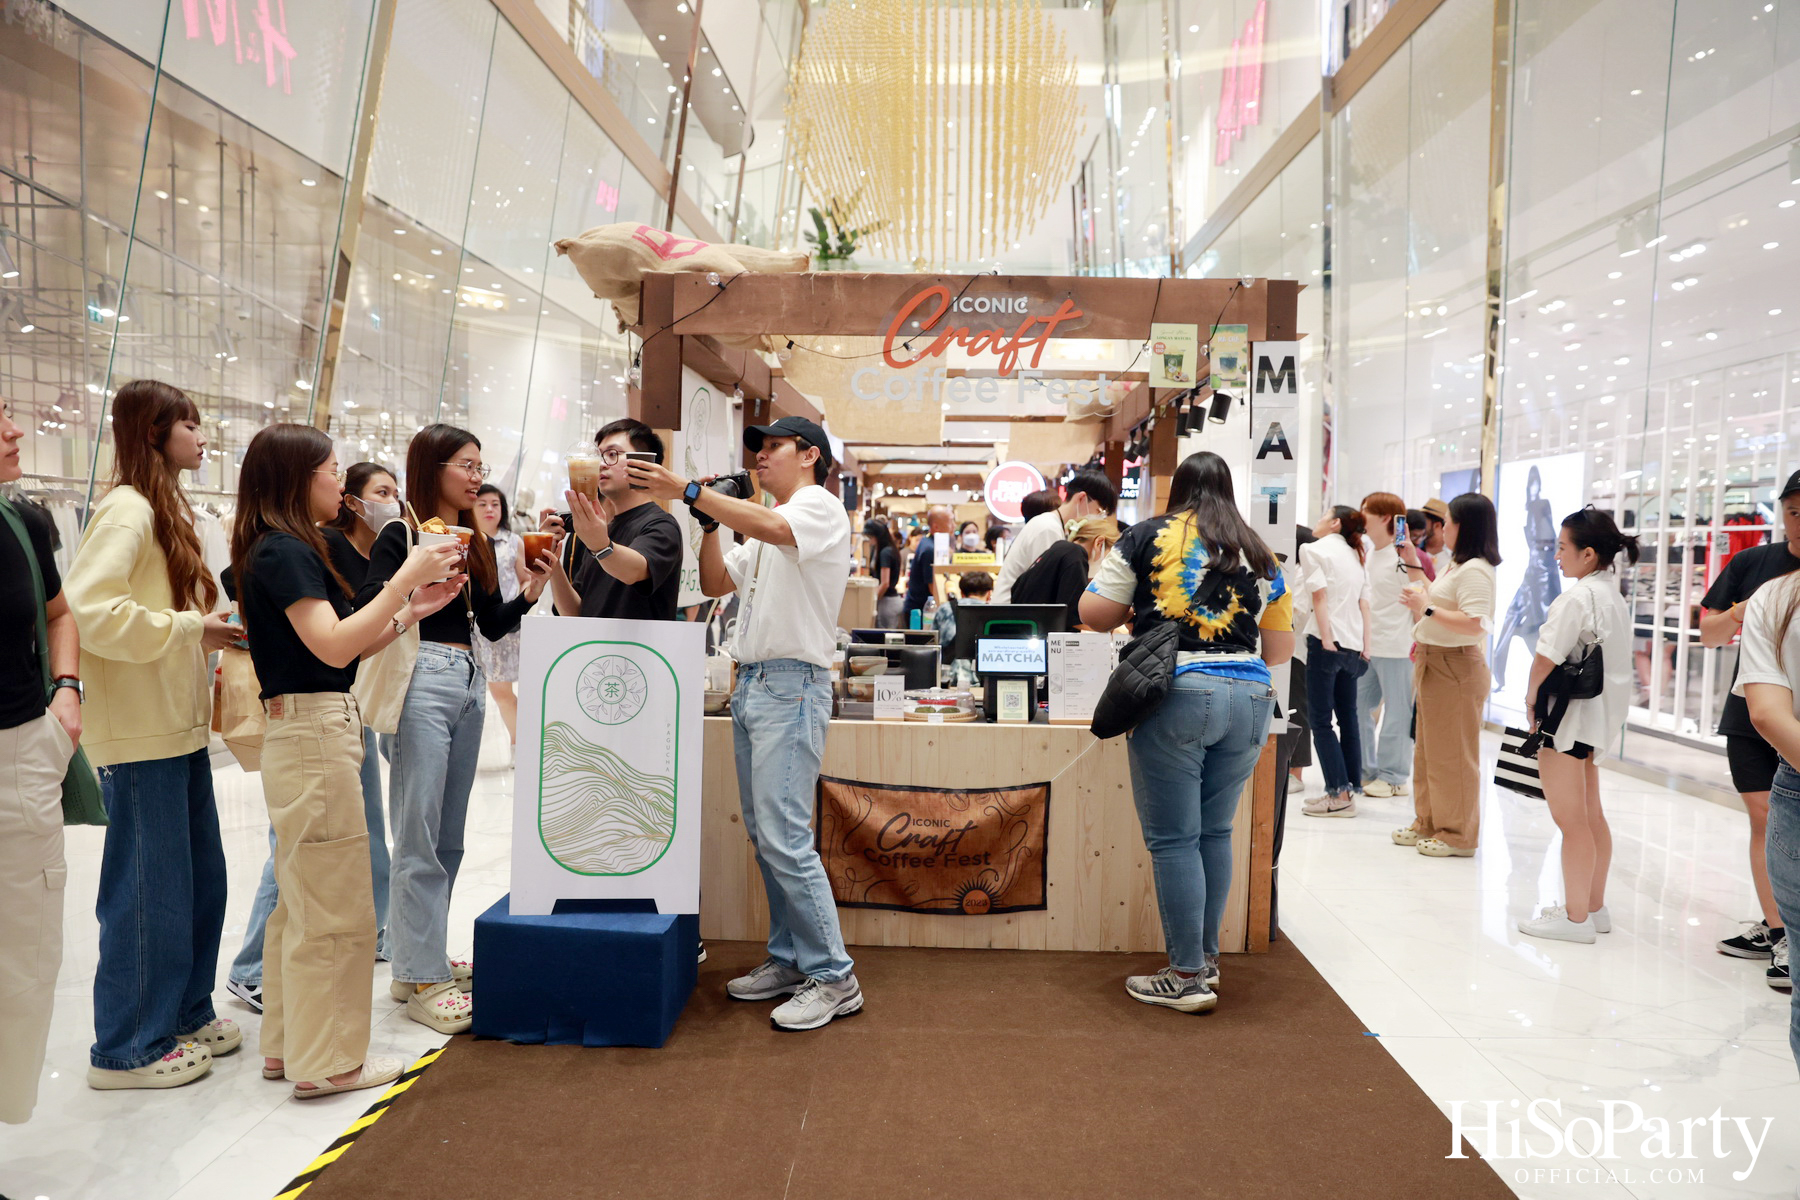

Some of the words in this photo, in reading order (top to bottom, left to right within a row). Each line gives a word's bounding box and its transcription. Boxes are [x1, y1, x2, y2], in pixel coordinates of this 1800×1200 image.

[953, 296, 1028, 314] ICONIC
[883, 285, 1083, 377] Craft
[851, 367, 1000, 402] Coffee
[1017, 371, 1112, 406] Fest
[982, 653, 1044, 663] MATCHA
[604, 682, 620, 698] 茶
[876, 688, 902, 702] 10%
[912, 818, 951, 828] ICONIC
[876, 811, 979, 857] Craft
[863, 847, 936, 869] Coffee
[944, 851, 992, 868] Fest
